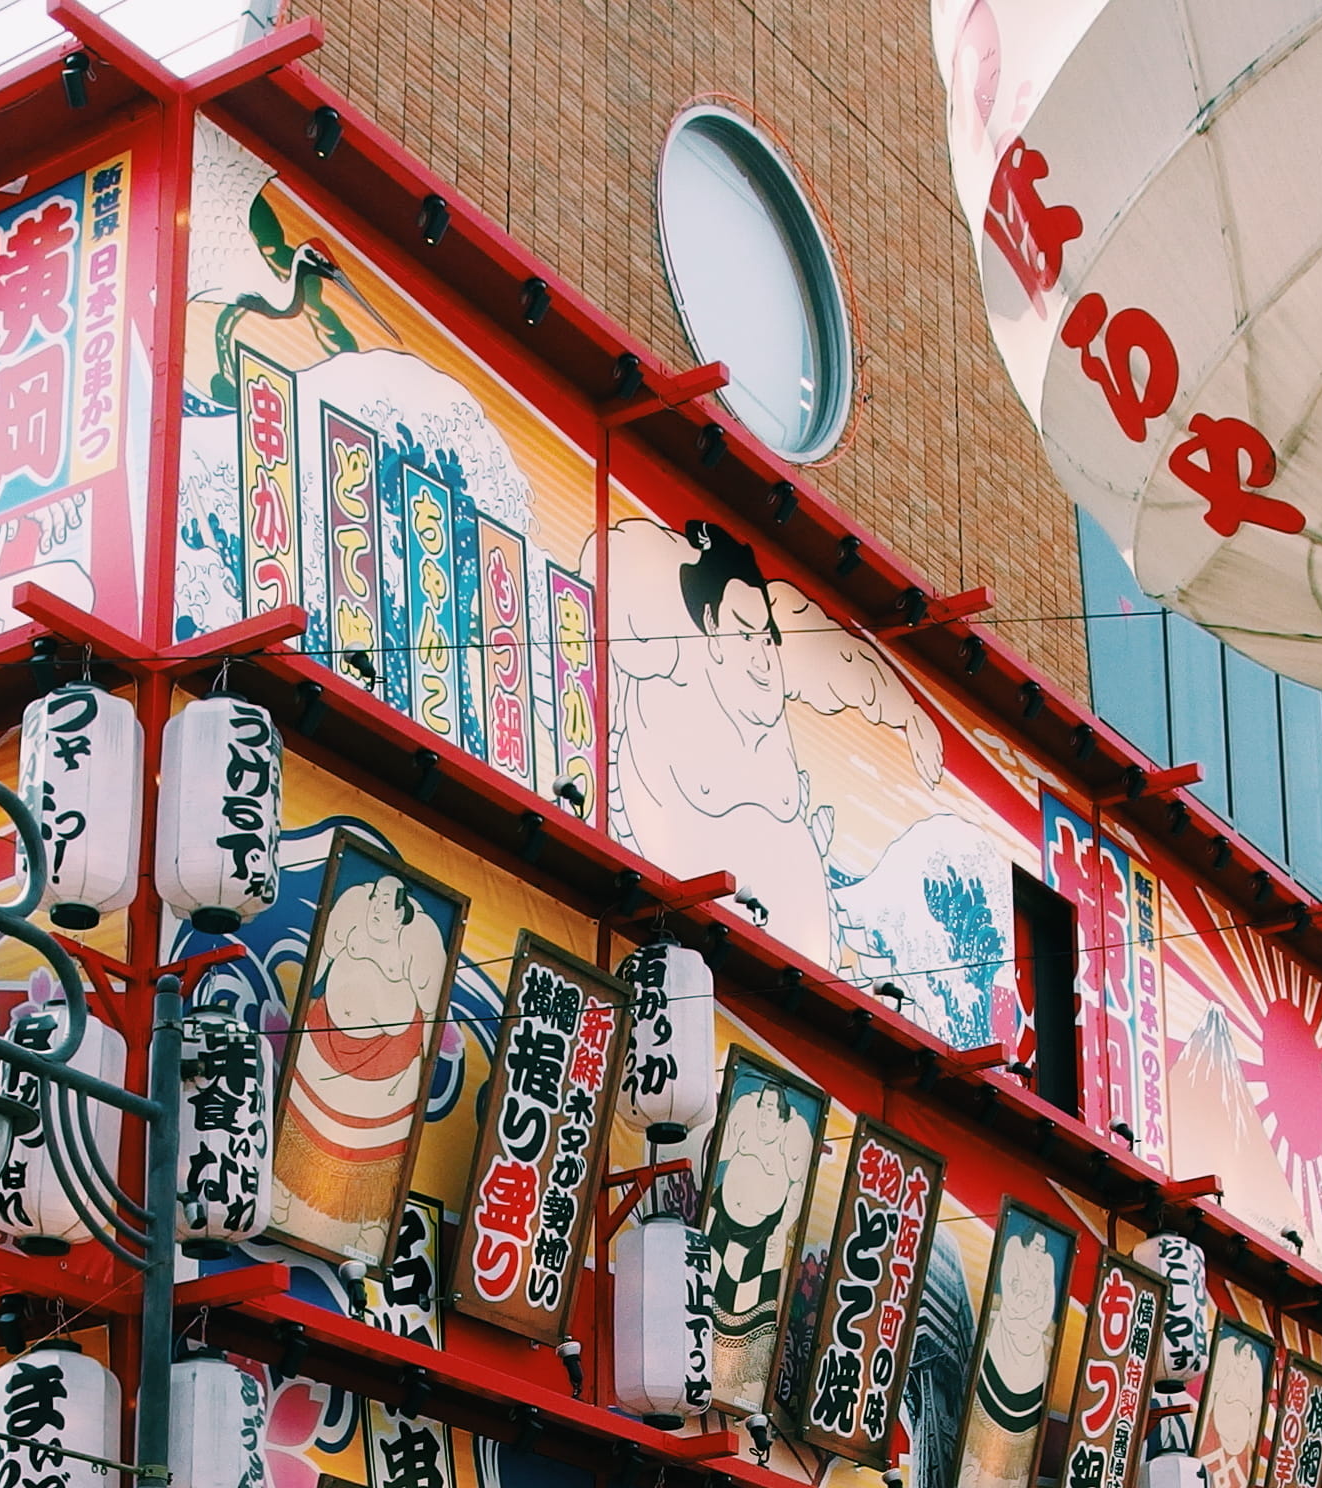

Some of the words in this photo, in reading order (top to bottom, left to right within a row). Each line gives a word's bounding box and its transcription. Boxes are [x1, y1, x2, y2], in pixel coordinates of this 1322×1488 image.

[90, 161, 124, 243] 新世界
[78, 243, 118, 463] 日本一の串かつ
[248, 375, 291, 616] 串かつ
[488, 548, 529, 776] もつ鍋
[523, 962, 584, 1034] 横綱
[1134, 868, 1158, 953] 新世界
[473, 1020, 571, 1302] 握り盛り
[526, 997, 615, 1312] 新鮮ネタが勢揃い
[856, 1143, 906, 1204] 名物
[861, 1166, 931, 1442] 大阪下町の味
